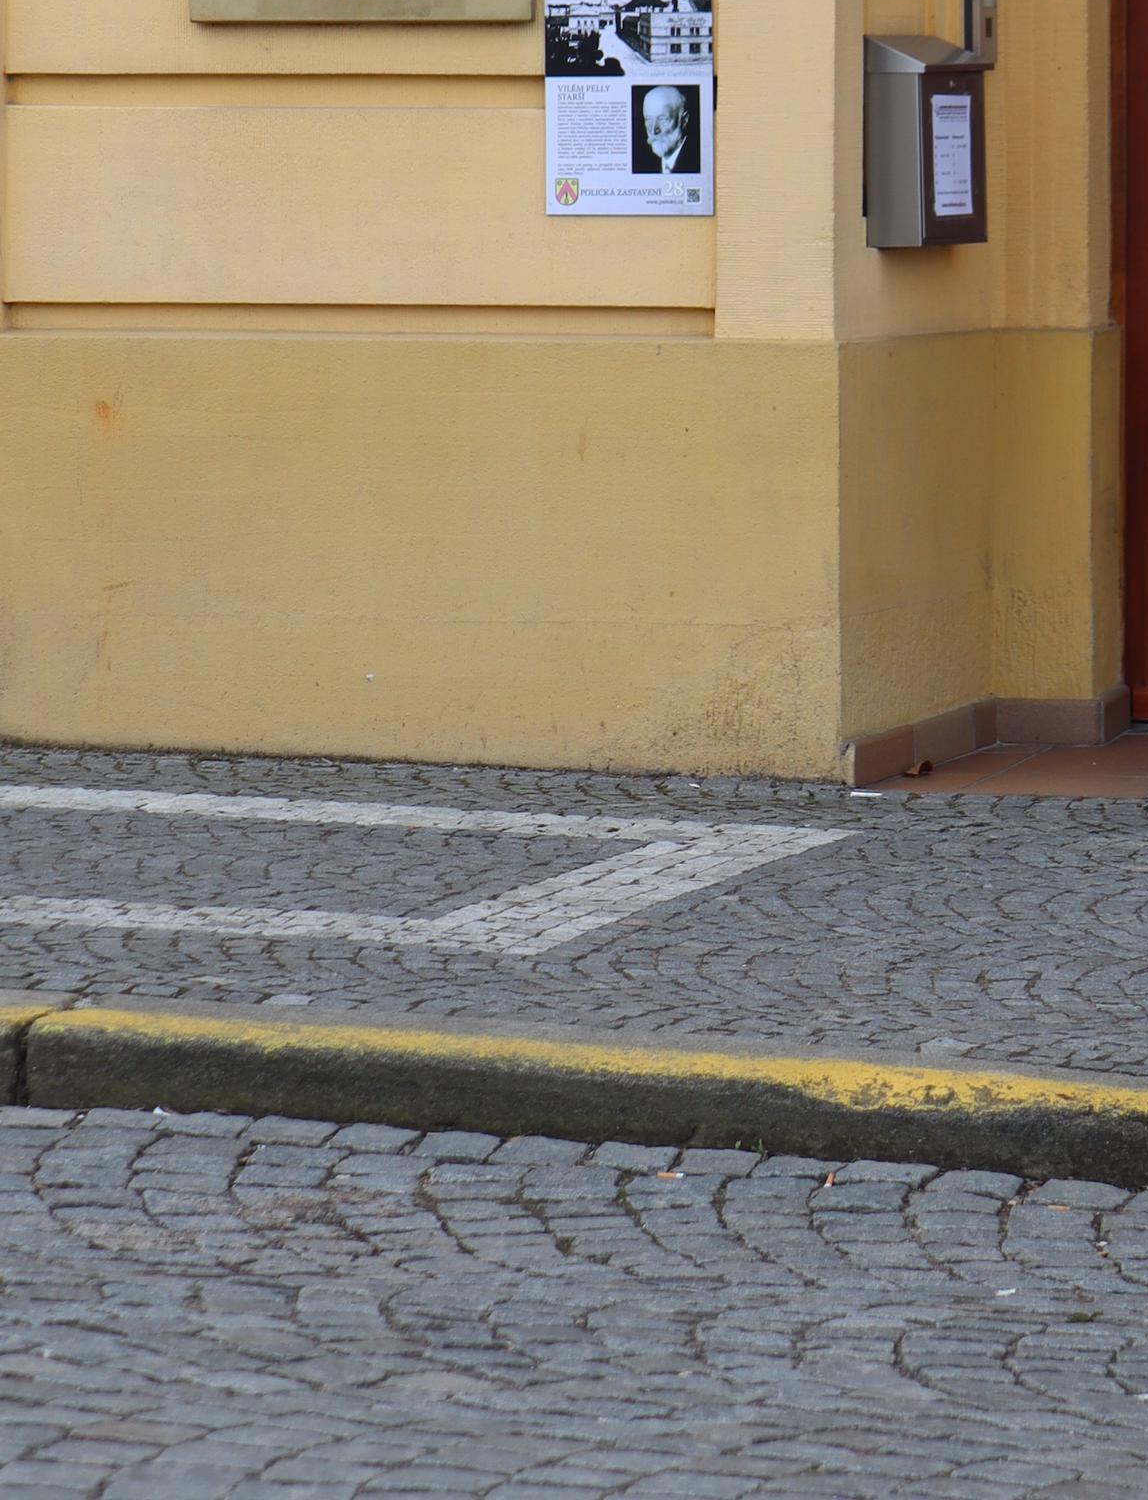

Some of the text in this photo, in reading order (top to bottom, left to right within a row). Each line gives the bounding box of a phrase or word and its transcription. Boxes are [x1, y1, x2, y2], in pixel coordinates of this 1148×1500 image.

[557, 84, 610, 92] VILÉM PELLY
[557, 92, 585, 101] STARŠÍ
[580, 180, 685, 197] POLICKÁ ZASTAVENÍ 28
